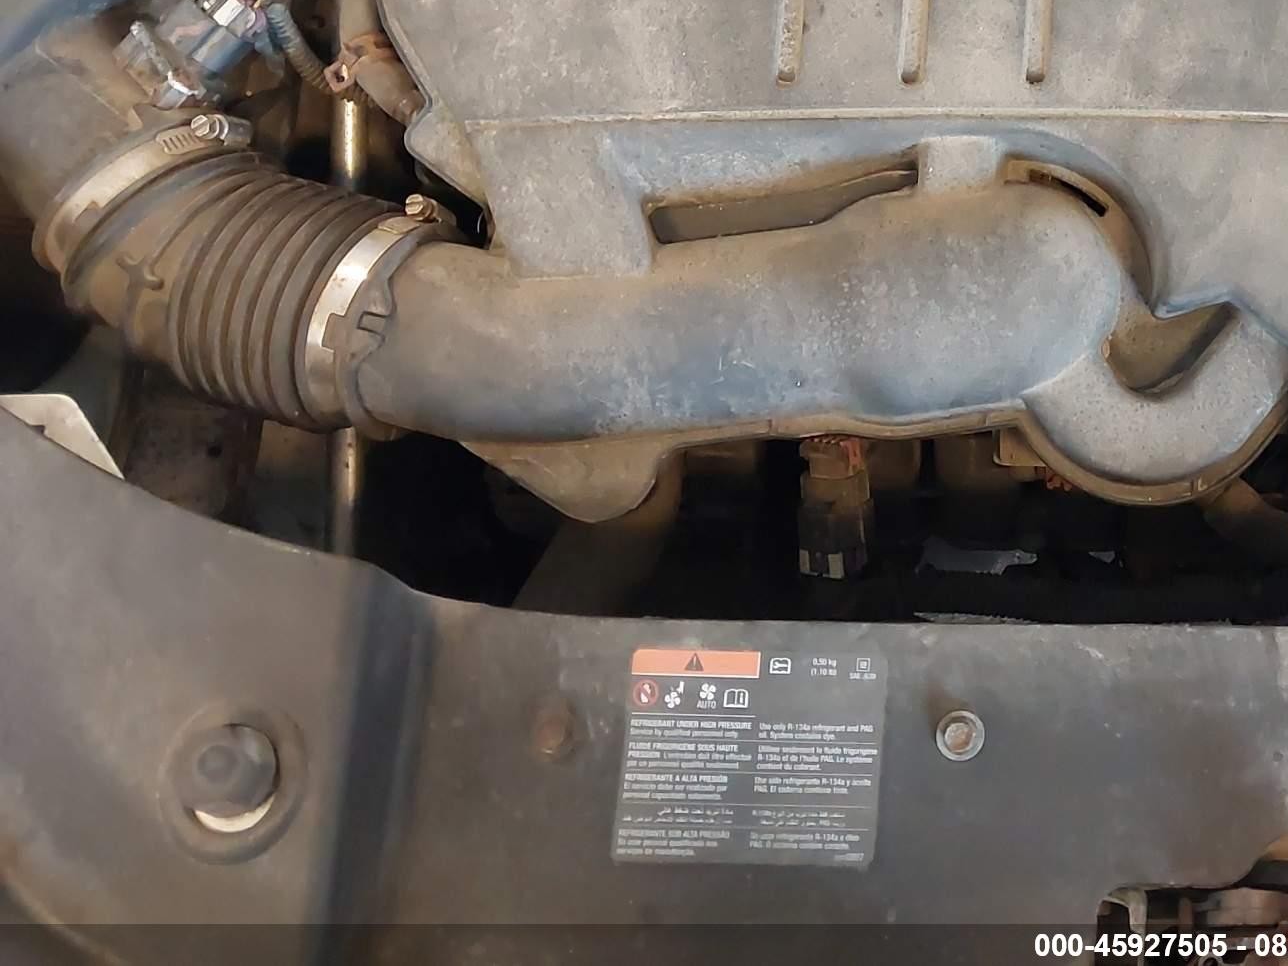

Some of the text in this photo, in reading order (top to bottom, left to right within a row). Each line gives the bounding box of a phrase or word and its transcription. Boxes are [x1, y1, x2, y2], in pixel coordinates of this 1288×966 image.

[697, 700, 717, 709] AUTO
[718, 722, 752, 730] PRESSURE
[787, 723, 811, 731] R-134a
[846, 724, 859, 732] and
